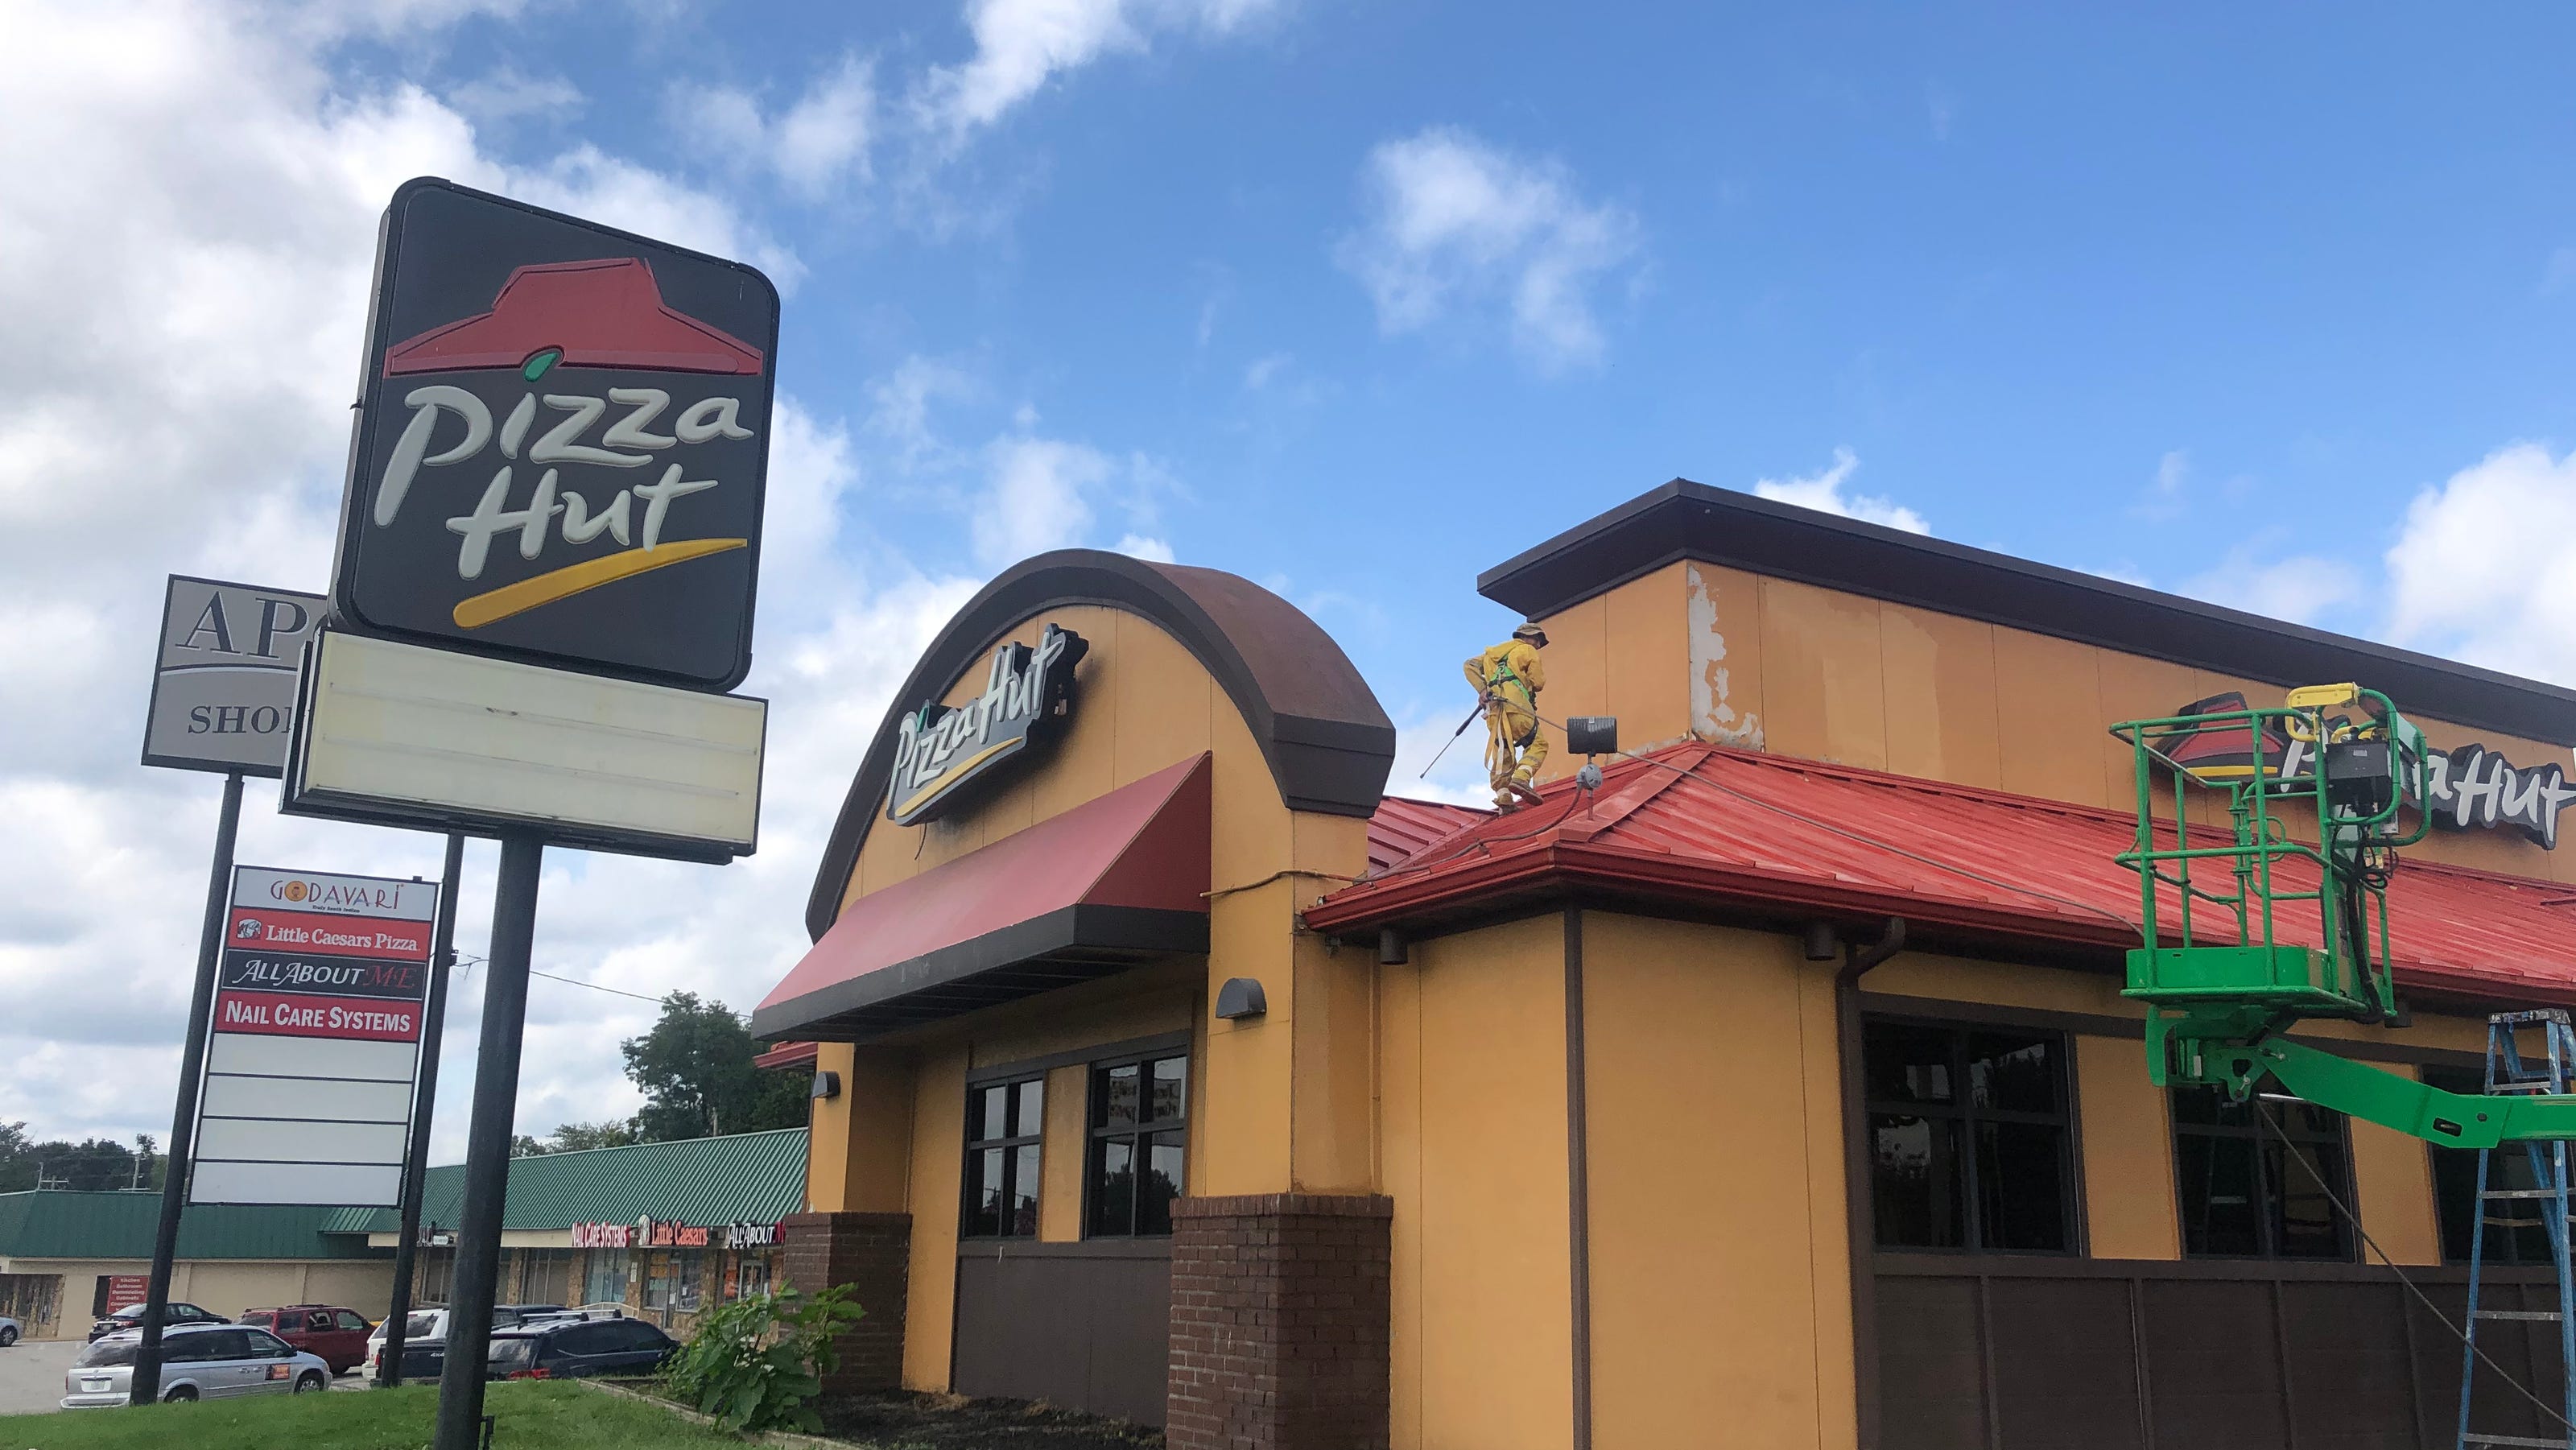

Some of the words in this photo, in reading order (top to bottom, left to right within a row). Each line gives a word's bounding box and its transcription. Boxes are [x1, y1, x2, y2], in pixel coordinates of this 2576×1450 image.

[374, 385, 755, 529] Pizza
[445, 463, 719, 580] Hut
[886, 704, 977, 812] Pizza
[978, 631, 1063, 746] Hut
[2452, 750, 2576, 842] Hut
[266, 924, 309, 944] Little
[312, 928, 372, 949] Caesars
[374, 933, 419, 952] Pizza
[363, 965, 417, 989] ME
[651, 1221, 673, 1246] Little
[675, 1221, 708, 1246] Caesars
